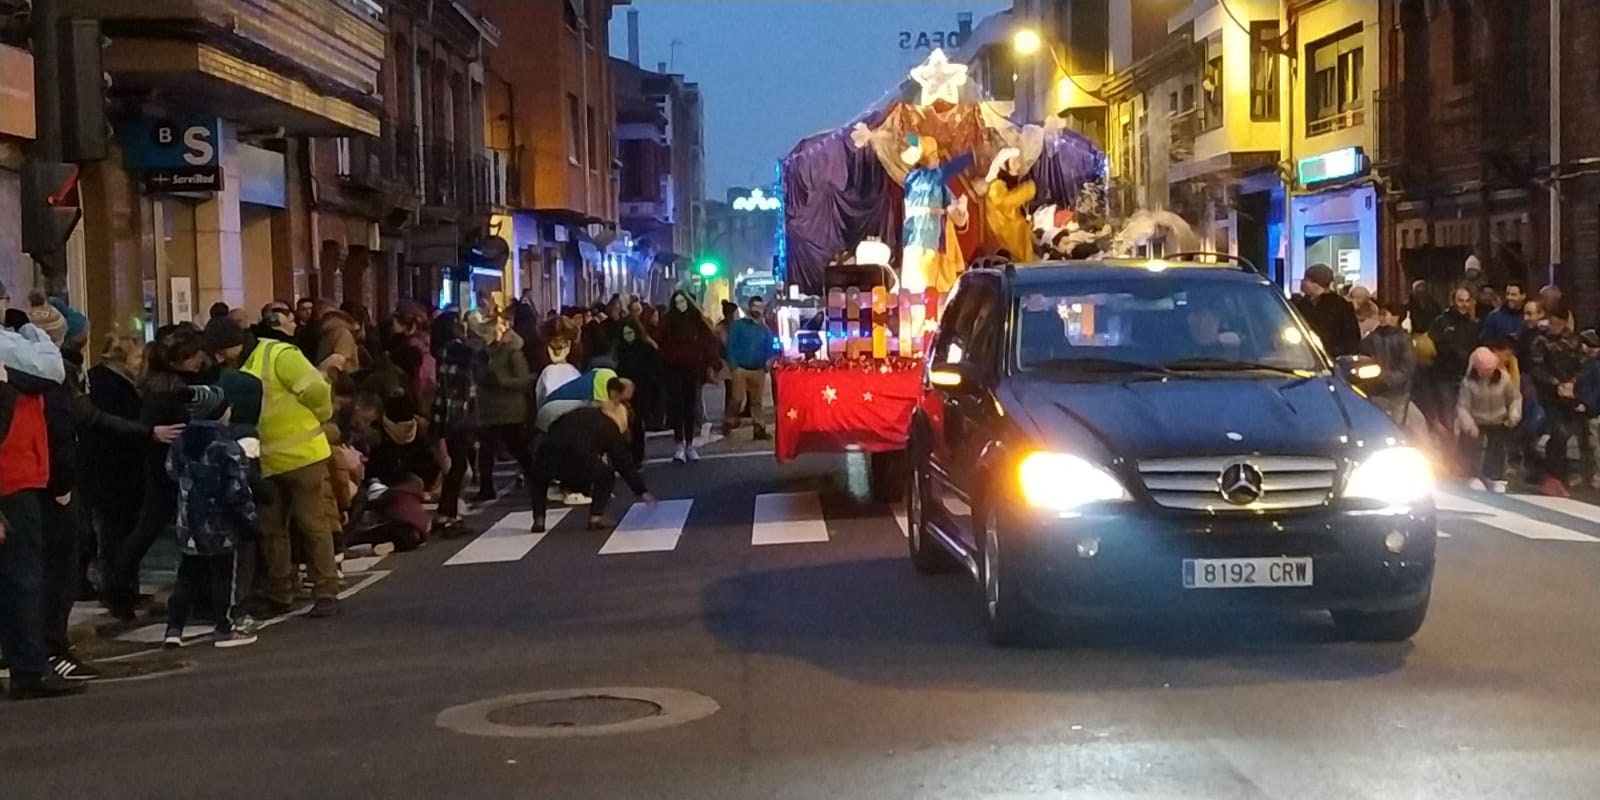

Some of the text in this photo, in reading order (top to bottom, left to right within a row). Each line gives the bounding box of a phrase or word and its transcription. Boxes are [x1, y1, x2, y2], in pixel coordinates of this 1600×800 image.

[159, 126, 214, 166] B S
[1204, 562, 1256, 584] 8192
[1270, 561, 1307, 583] CRW
